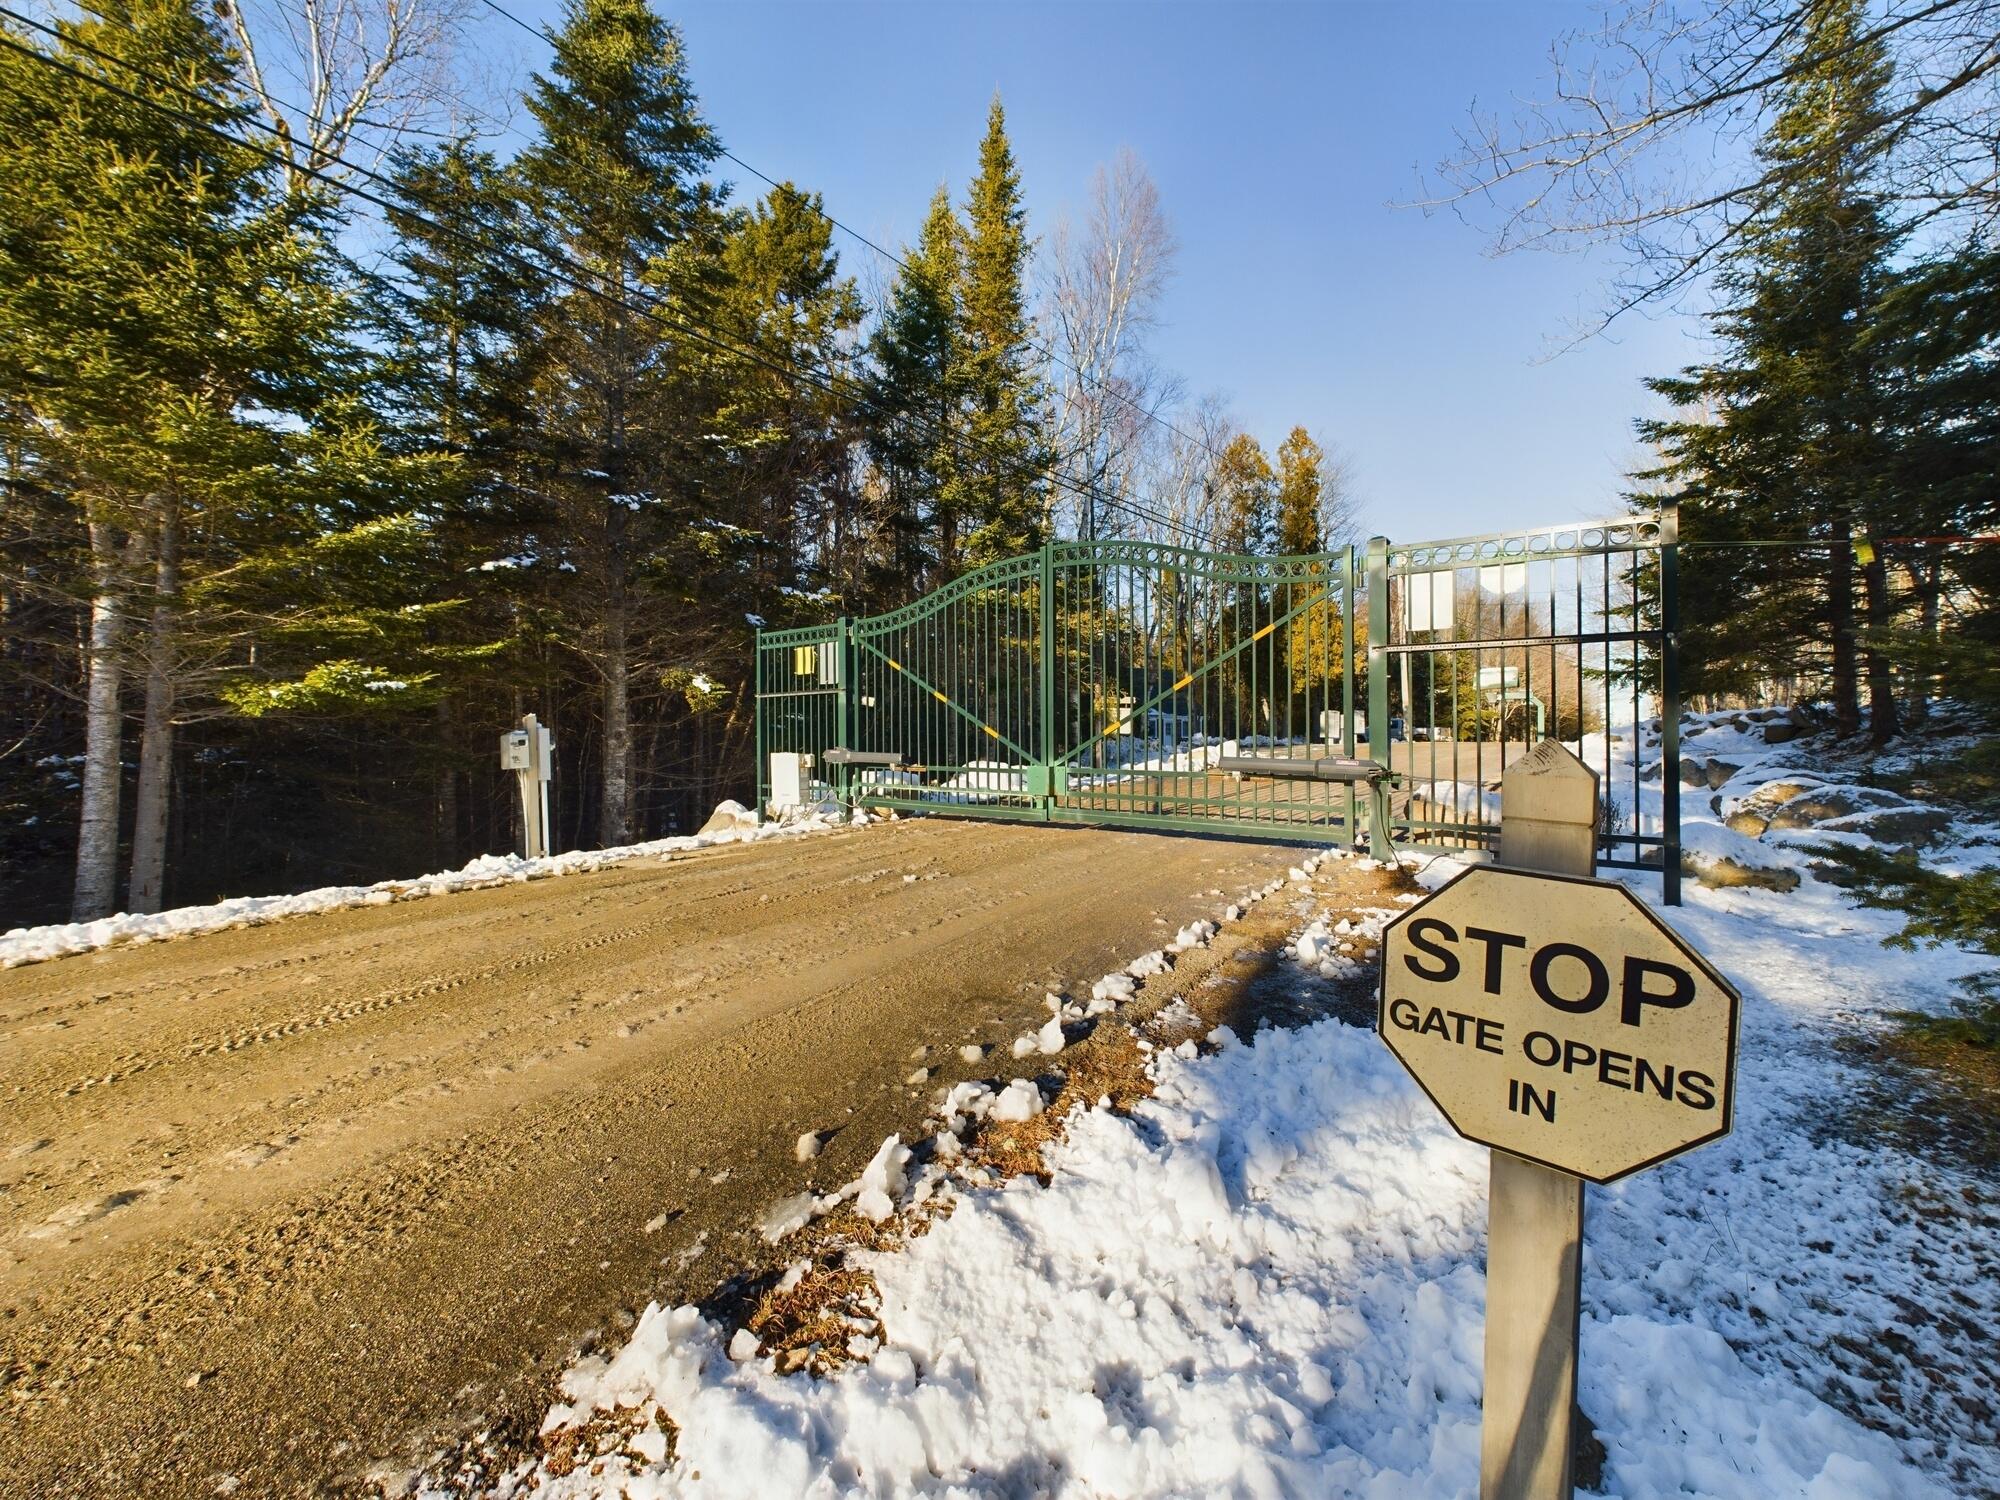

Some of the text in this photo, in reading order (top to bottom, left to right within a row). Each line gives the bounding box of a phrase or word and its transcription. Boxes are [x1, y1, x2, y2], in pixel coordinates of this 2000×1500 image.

[1403, 917, 1697, 1028] STOP
[1389, 998, 1716, 1111] GATE OPENS
[1507, 1078, 1556, 1124] IN
